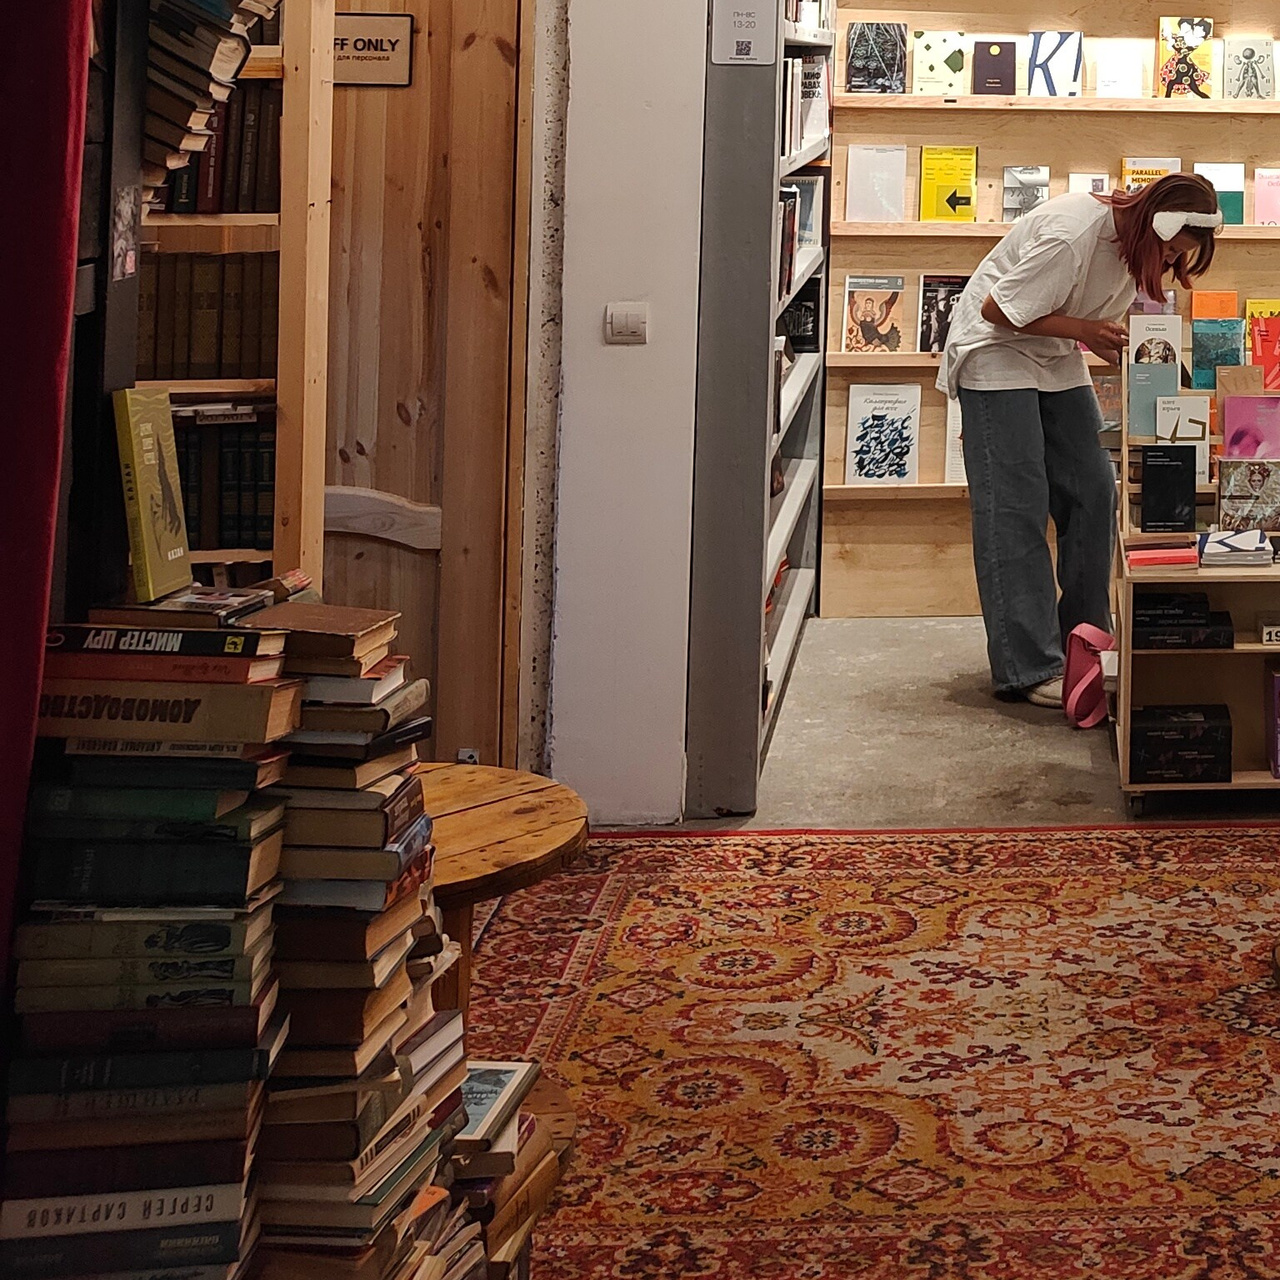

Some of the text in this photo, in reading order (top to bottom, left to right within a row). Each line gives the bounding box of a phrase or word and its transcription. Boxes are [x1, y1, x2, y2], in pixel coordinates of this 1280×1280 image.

[733, 20, 757, 29] 13-20
[353, 37, 400, 52] ONLY
[803, 71, 821, 80] МИФ
[800, 80, 821, 89] РАВАХ
[82, 629, 184, 652] МИСТЕР ЦРУ
[40, 693, 202, 724] ДОМОВОДСТВО
[26, 1193, 214, 1228] СЕРГЕЙ САРТАКОВ
